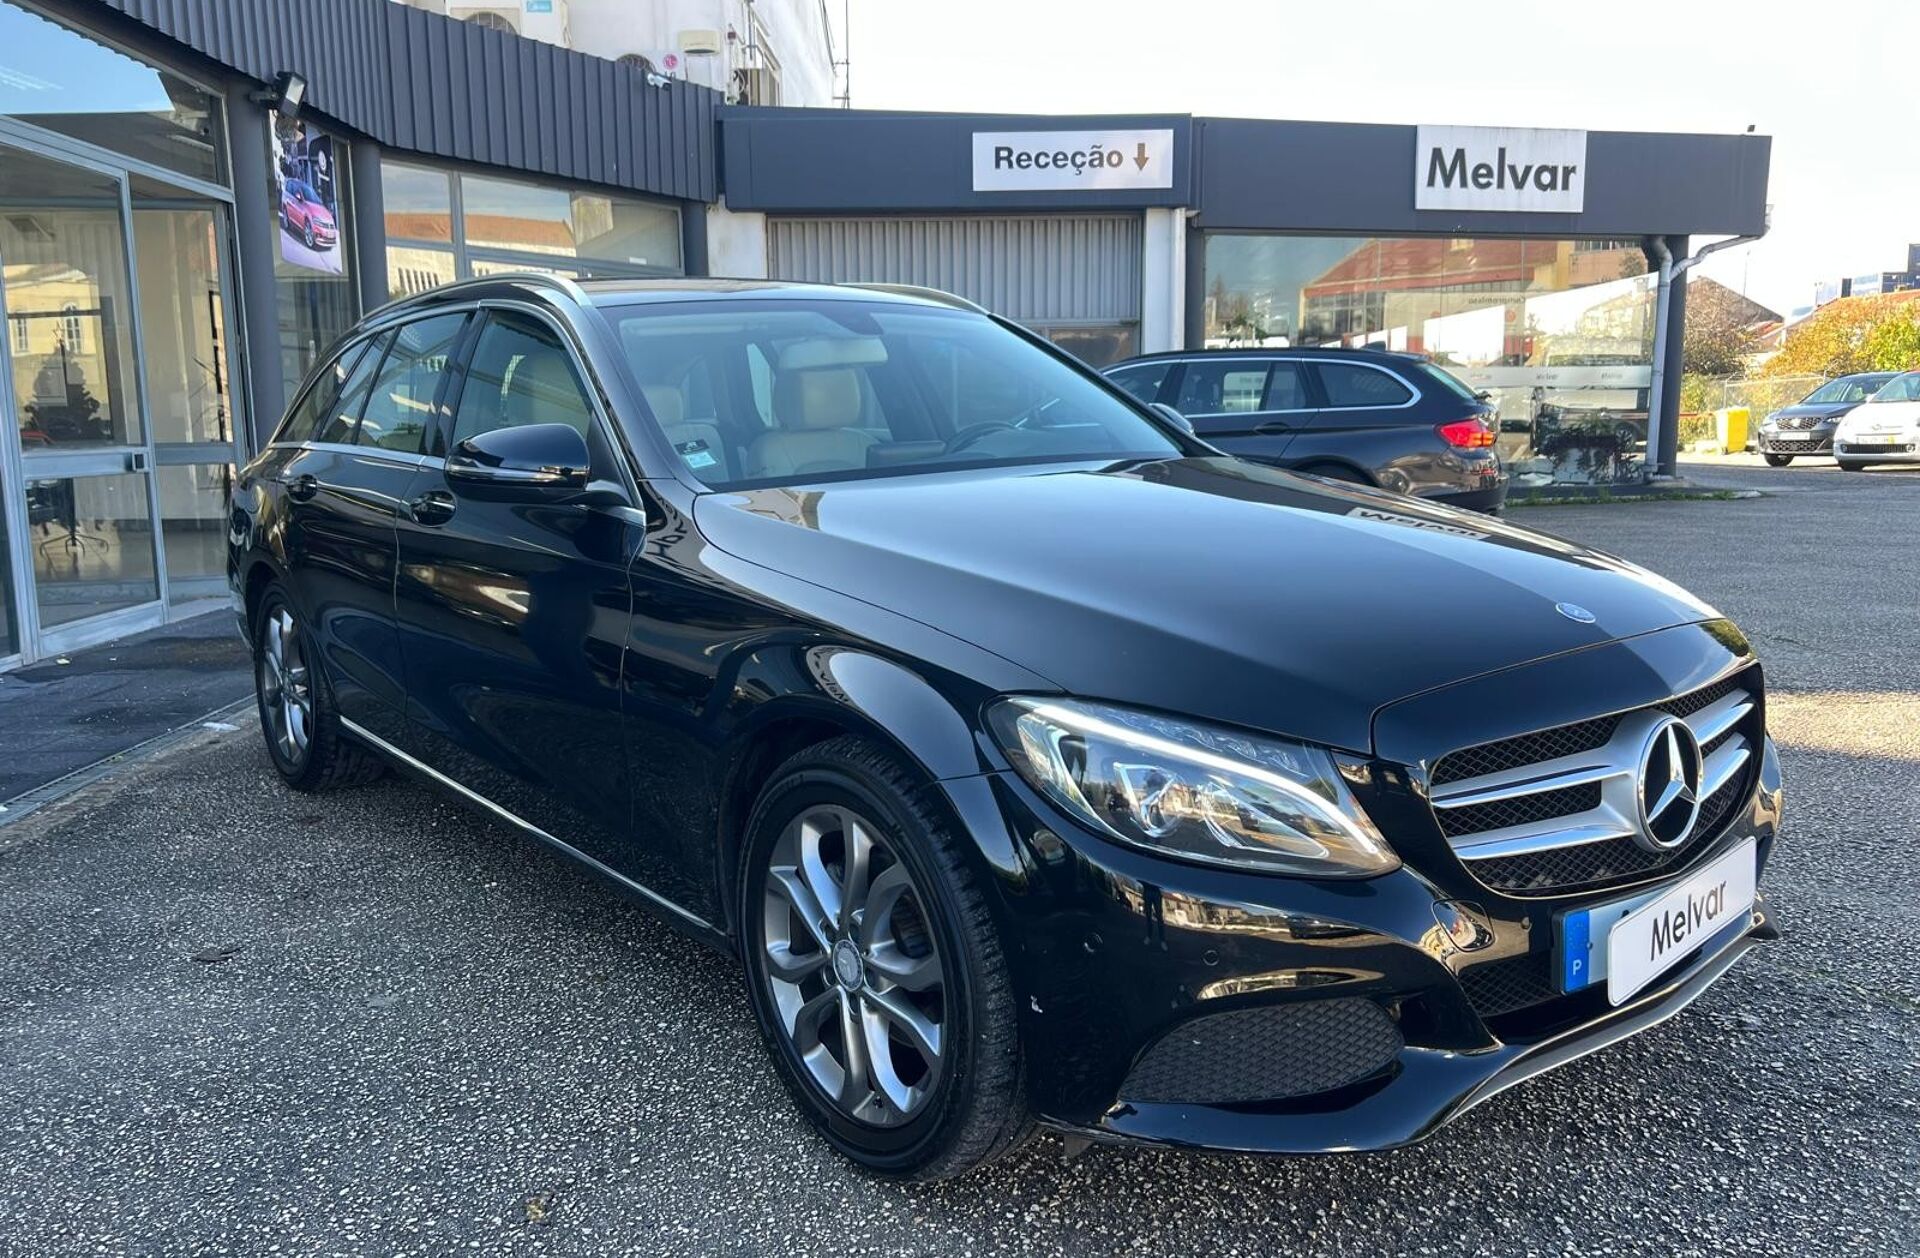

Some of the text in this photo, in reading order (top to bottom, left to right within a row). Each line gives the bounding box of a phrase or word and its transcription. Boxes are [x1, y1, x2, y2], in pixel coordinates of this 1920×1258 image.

[994, 144, 1123, 176] Receção
[1426, 147, 1577, 192] Melvar
[1650, 880, 1727, 962] Melvar
[1572, 959, 1582, 975] P
